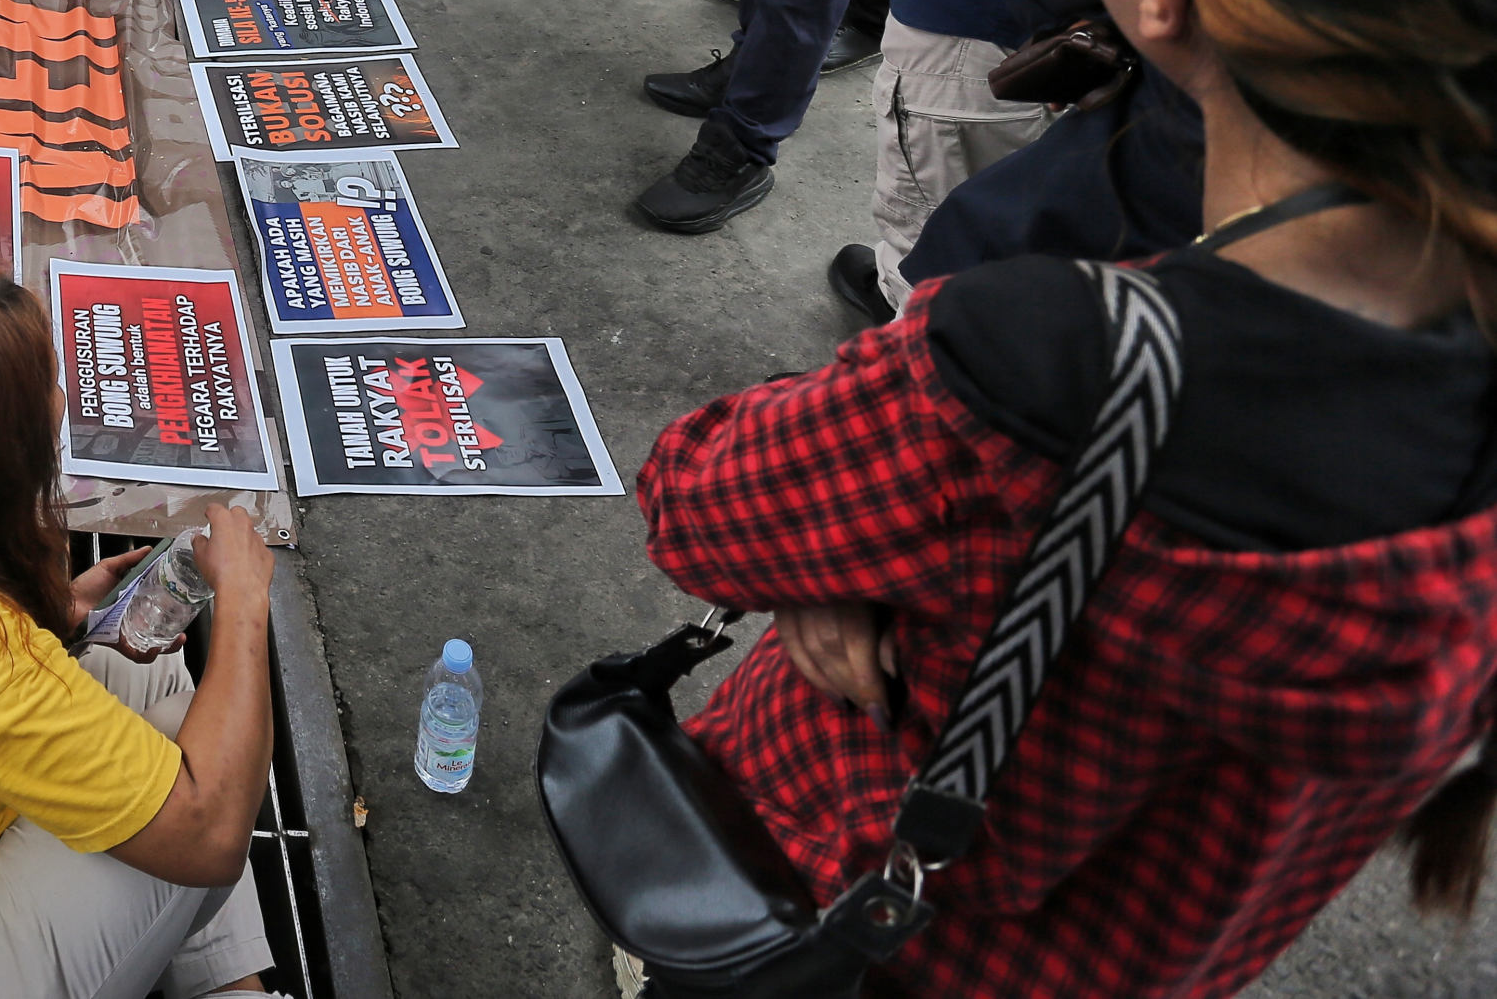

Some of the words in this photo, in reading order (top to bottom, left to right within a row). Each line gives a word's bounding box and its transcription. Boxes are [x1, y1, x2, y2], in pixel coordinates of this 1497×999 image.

[212, 18, 236, 47] DIMANA
[233, 20, 262, 44] SILA
[273, 31, 291, 48] yang
[296, 3, 318, 31] sosial
[247, 72, 296, 144] BUKAN
[280, 71, 332, 142] SOLUSI
[313, 72, 353, 138] BAGAIMANA
[331, 72, 354, 102] KAMI
[346, 66, 391, 139] SELANJUTNYA
[378, 82, 422, 118] ???
[343, 102, 370, 136] NASIB
[336, 176, 397, 212] !?
[265, 216, 288, 246] ADA
[285, 218, 314, 262] MASIH
[330, 227, 357, 260] DARI
[370, 213, 411, 267] SUWUNG
[273, 248, 306, 309] APAKAH
[300, 265, 327, 309] YANG
[306, 216, 351, 308] MEMIKIRKAN
[343, 262, 373, 307] NASIB
[347, 216, 395, 306] ANAK-ANAK
[390, 269, 426, 306] BONG
[92, 303, 128, 376] SUWUNG
[126, 323, 146, 366] bentuk
[175, 294, 207, 377] TERHADAP
[73, 309, 99, 418] PENGGUSURAN
[131, 367, 152, 410] adalah
[141, 297, 193, 446] PENGKHIANATAN
[203, 321, 239, 421] RAKYATNYA
[323, 355, 362, 407] UNTUK
[99, 379, 135, 429] BONG
[190, 380, 220, 452] NEGARA
[357, 355, 415, 468] RAKYAT
[393, 357, 456, 468] TOLAK
[432, 356, 487, 470] STERILISASI
[336, 411, 378, 470] TANAH
